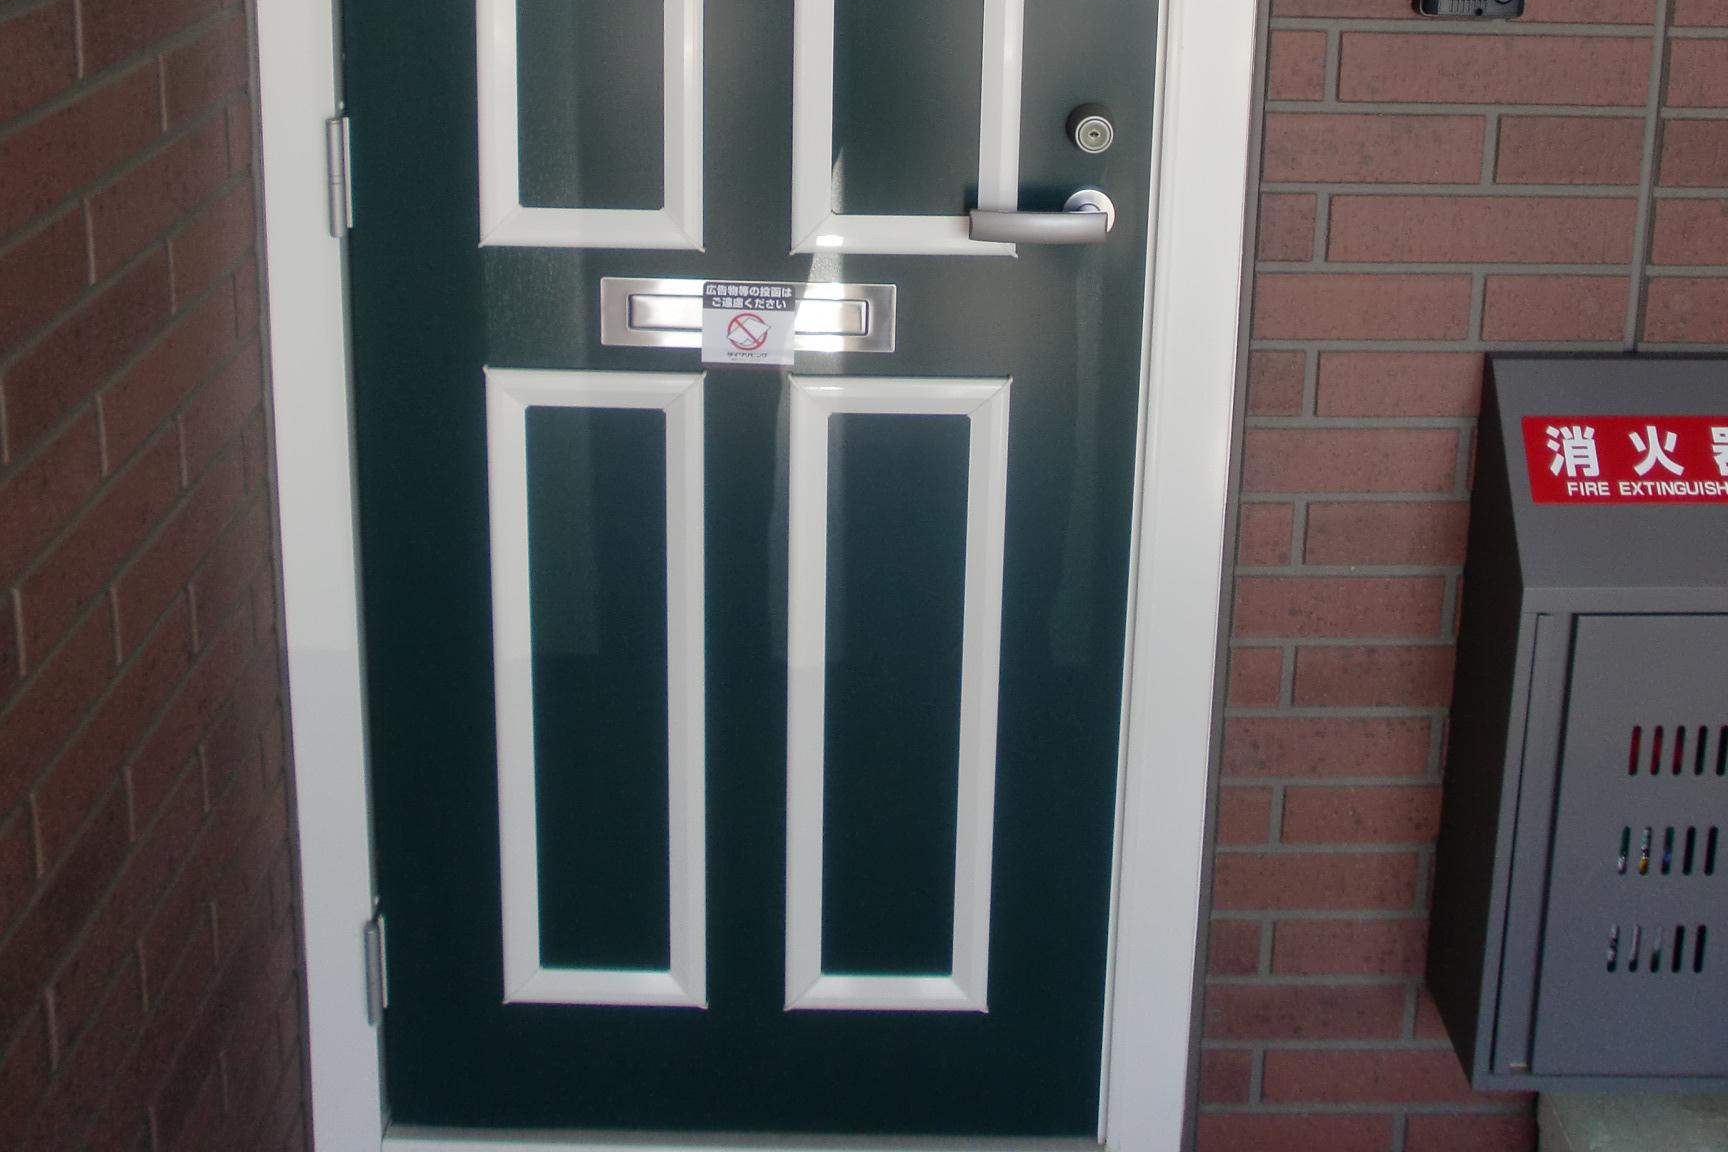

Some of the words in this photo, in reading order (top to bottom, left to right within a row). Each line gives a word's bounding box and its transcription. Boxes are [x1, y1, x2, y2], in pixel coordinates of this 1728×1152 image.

[711, 297, 787, 309] ご遠慮ください
[1567, 481, 1611, 497] FIRE
[1619, 481, 1728, 497] EXTINGUISH
